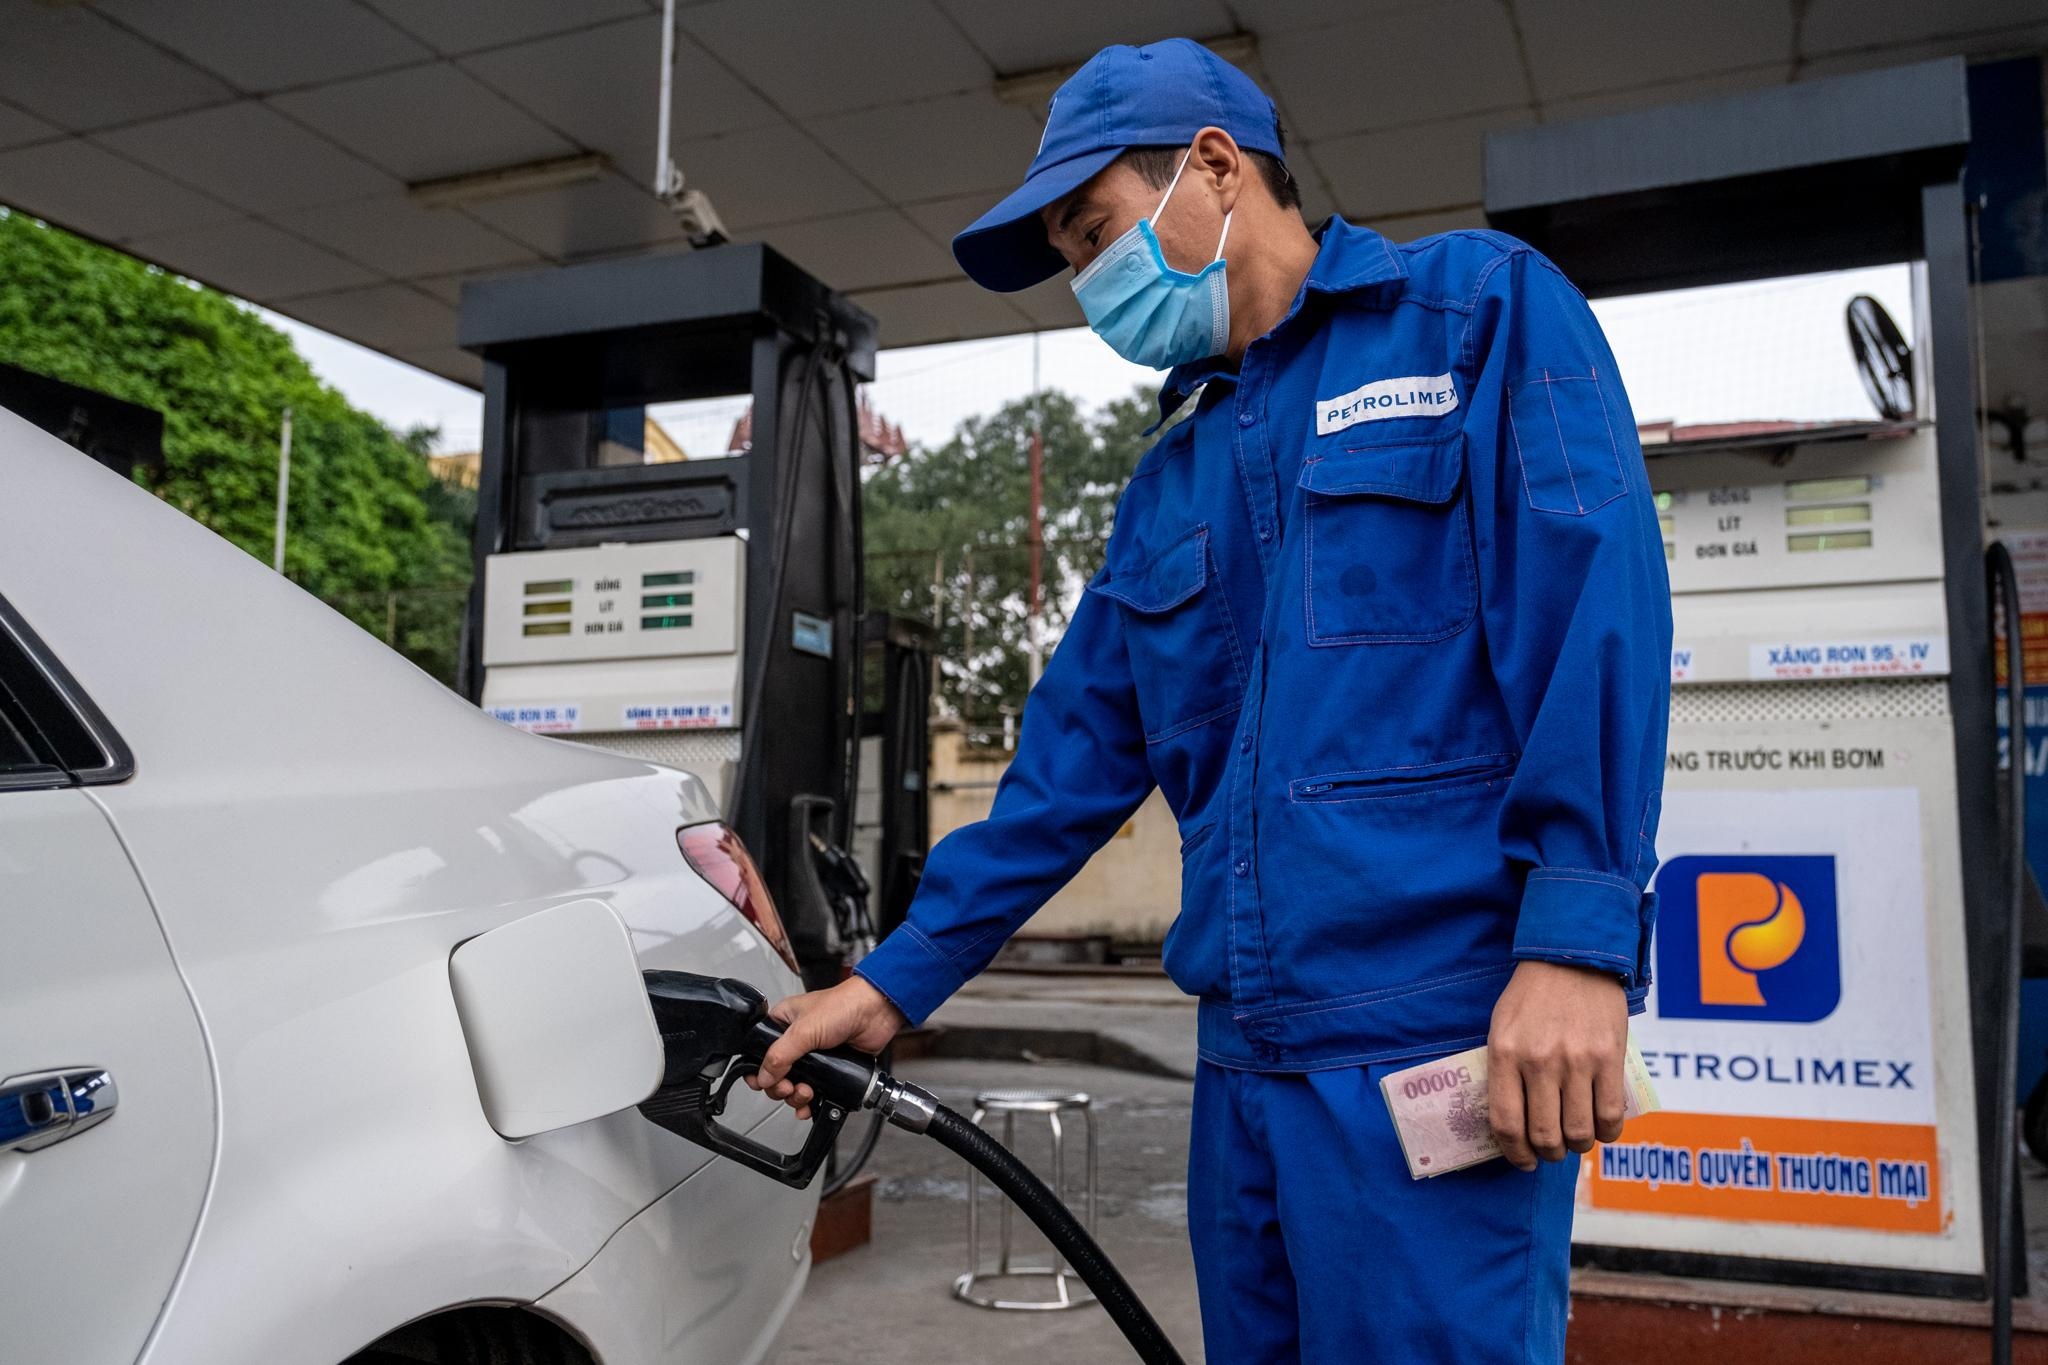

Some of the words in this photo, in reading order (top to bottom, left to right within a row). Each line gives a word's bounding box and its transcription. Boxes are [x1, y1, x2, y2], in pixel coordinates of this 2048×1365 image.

[1327, 388, 1456, 423] PETROLIMEX
[1733, 541, 1758, 556] GIÁ
[1827, 645, 1867, 663] RON
[1872, 644, 1894, 661] 95
[1909, 643, 1929, 660] IV
[1707, 746, 1783, 770] TRƯỚC
[1789, 750, 1825, 769] KHI
[1832, 747, 1885, 769] BƠM
[1403, 1066, 1471, 1099] 50000
[1641, 1051, 1915, 1090] ETROLIMEX
[1602, 1146, 1692, 1190] NHƯỢNG
[1699, 1139, 1771, 1190] QUYỀN
[1777, 1153, 1872, 1197] THƯƠNG
[1877, 1161, 1931, 1208] MẠI
